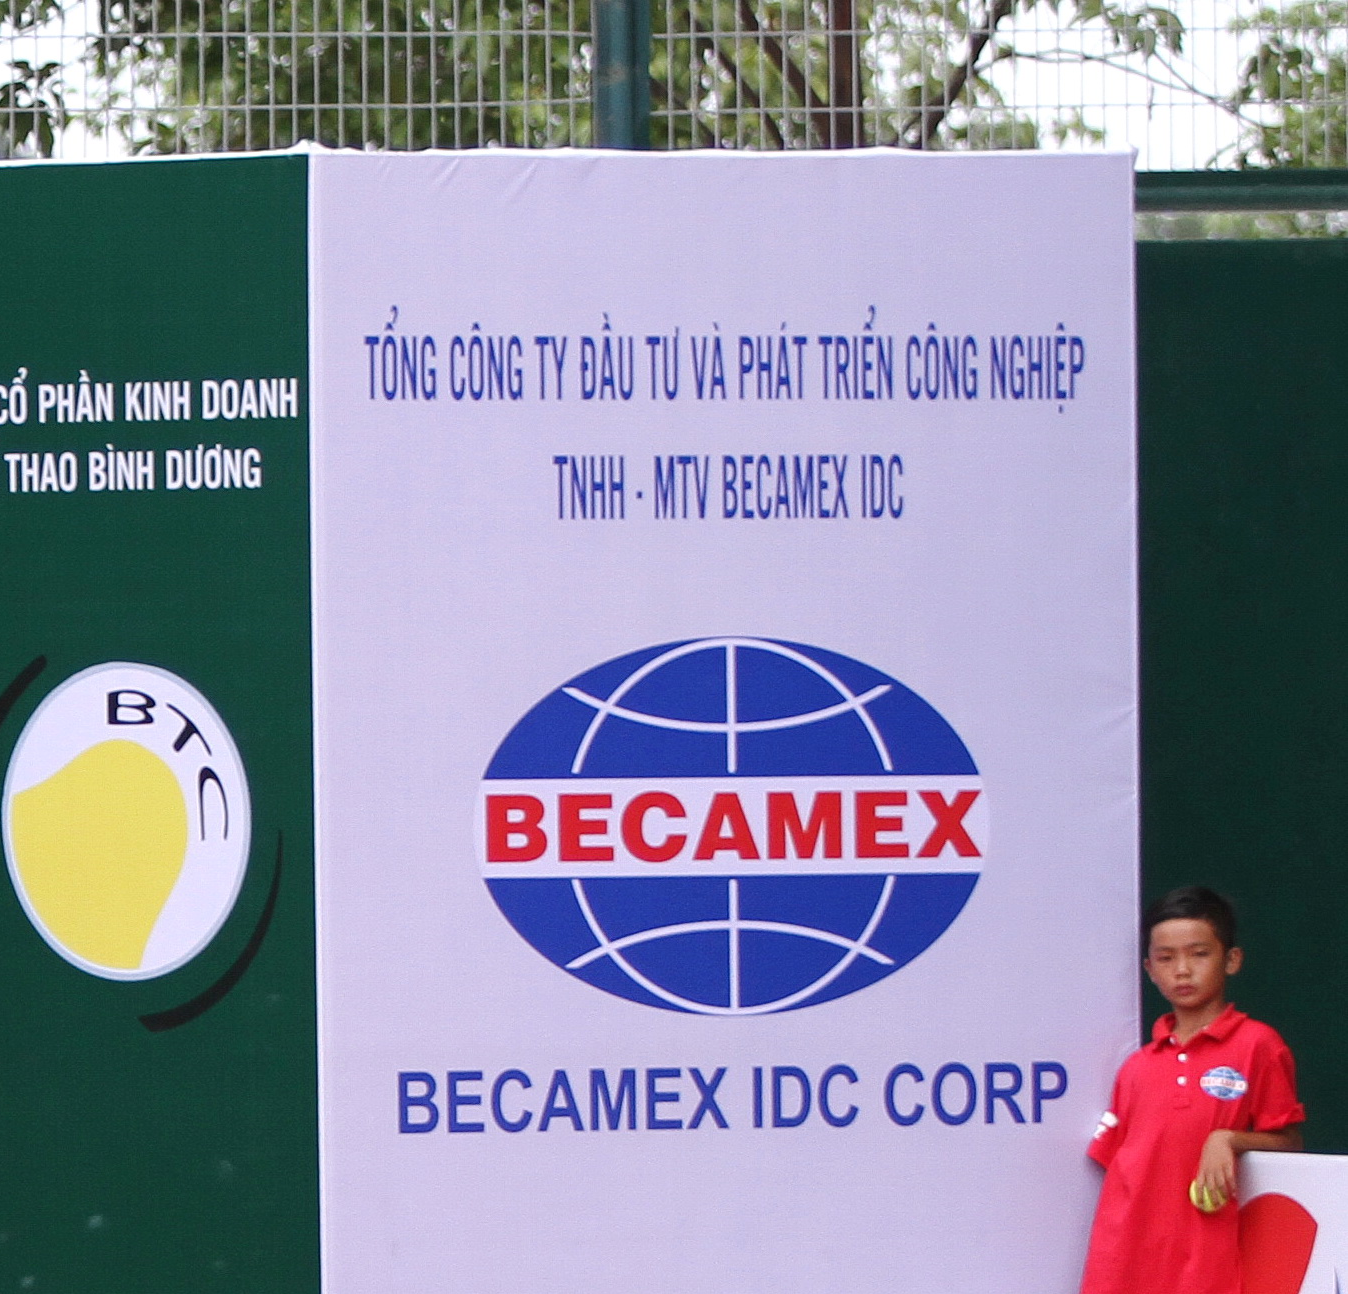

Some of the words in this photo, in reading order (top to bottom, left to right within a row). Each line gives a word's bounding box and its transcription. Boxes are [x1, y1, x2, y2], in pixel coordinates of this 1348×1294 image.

[363, 304, 437, 401] TỔNG
[449, 321, 523, 401] CÔNG
[534, 335, 567, 400] TY
[579, 312, 634, 400] ĐẦU
[646, 326, 680, 400] TƯ
[691, 321, 727, 400] VÀ
[738, 321, 807, 400] PHÁT
[818, 304, 893, 400] TRIỂN
[905, 321, 978, 400] CÔNG
[989, 321, 1085, 414] NGHIỆP
[38, 369, 114, 423] PHẦN
[125, 380, 191, 421] KINH
[202, 377, 298, 420] DOANH
[4, 451, 78, 492] THAO
[88, 443, 155, 491] BÌNH
[165, 443, 261, 489] DƯƠNG
[553, 454, 625, 519] TNHH
[654, 455, 709, 519] MTV
[722, 454, 849, 518] BECAMEX
[861, 454, 904, 518] IDC
[106, 689, 229, 842] BTC
[485, 789, 982, 863] BECAMEX
[396, 1066, 730, 1134] BECAMEX
[752, 1064, 859, 1129] IDC
[883, 1061, 1068, 1126] CORP
